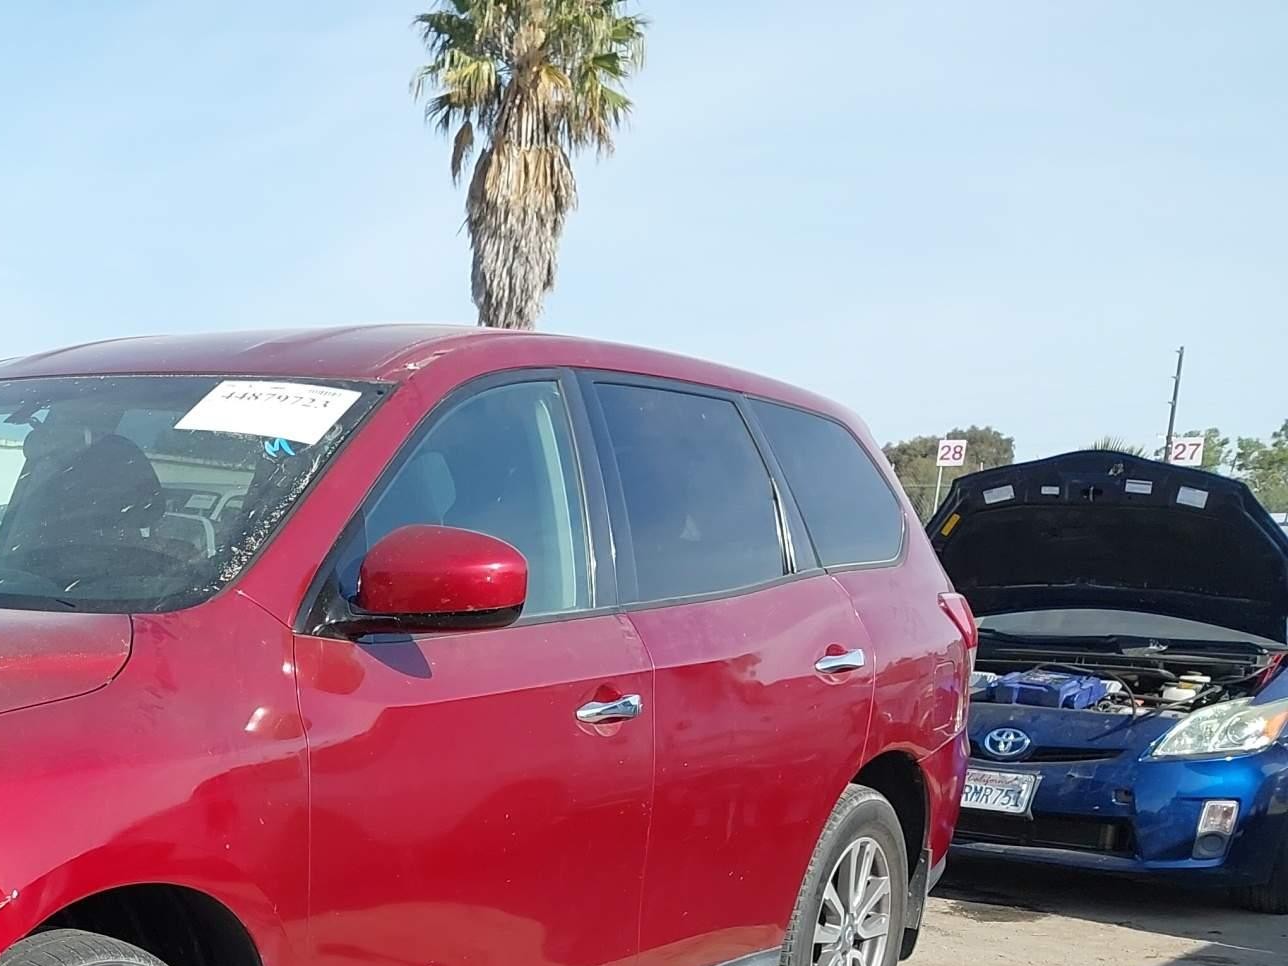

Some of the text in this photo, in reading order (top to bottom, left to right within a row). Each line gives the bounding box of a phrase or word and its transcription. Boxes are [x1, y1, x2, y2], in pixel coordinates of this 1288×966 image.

[222, 391, 330, 408] 44879723
[939, 444, 963, 461] 28
[1173, 442, 1202, 461] 27
